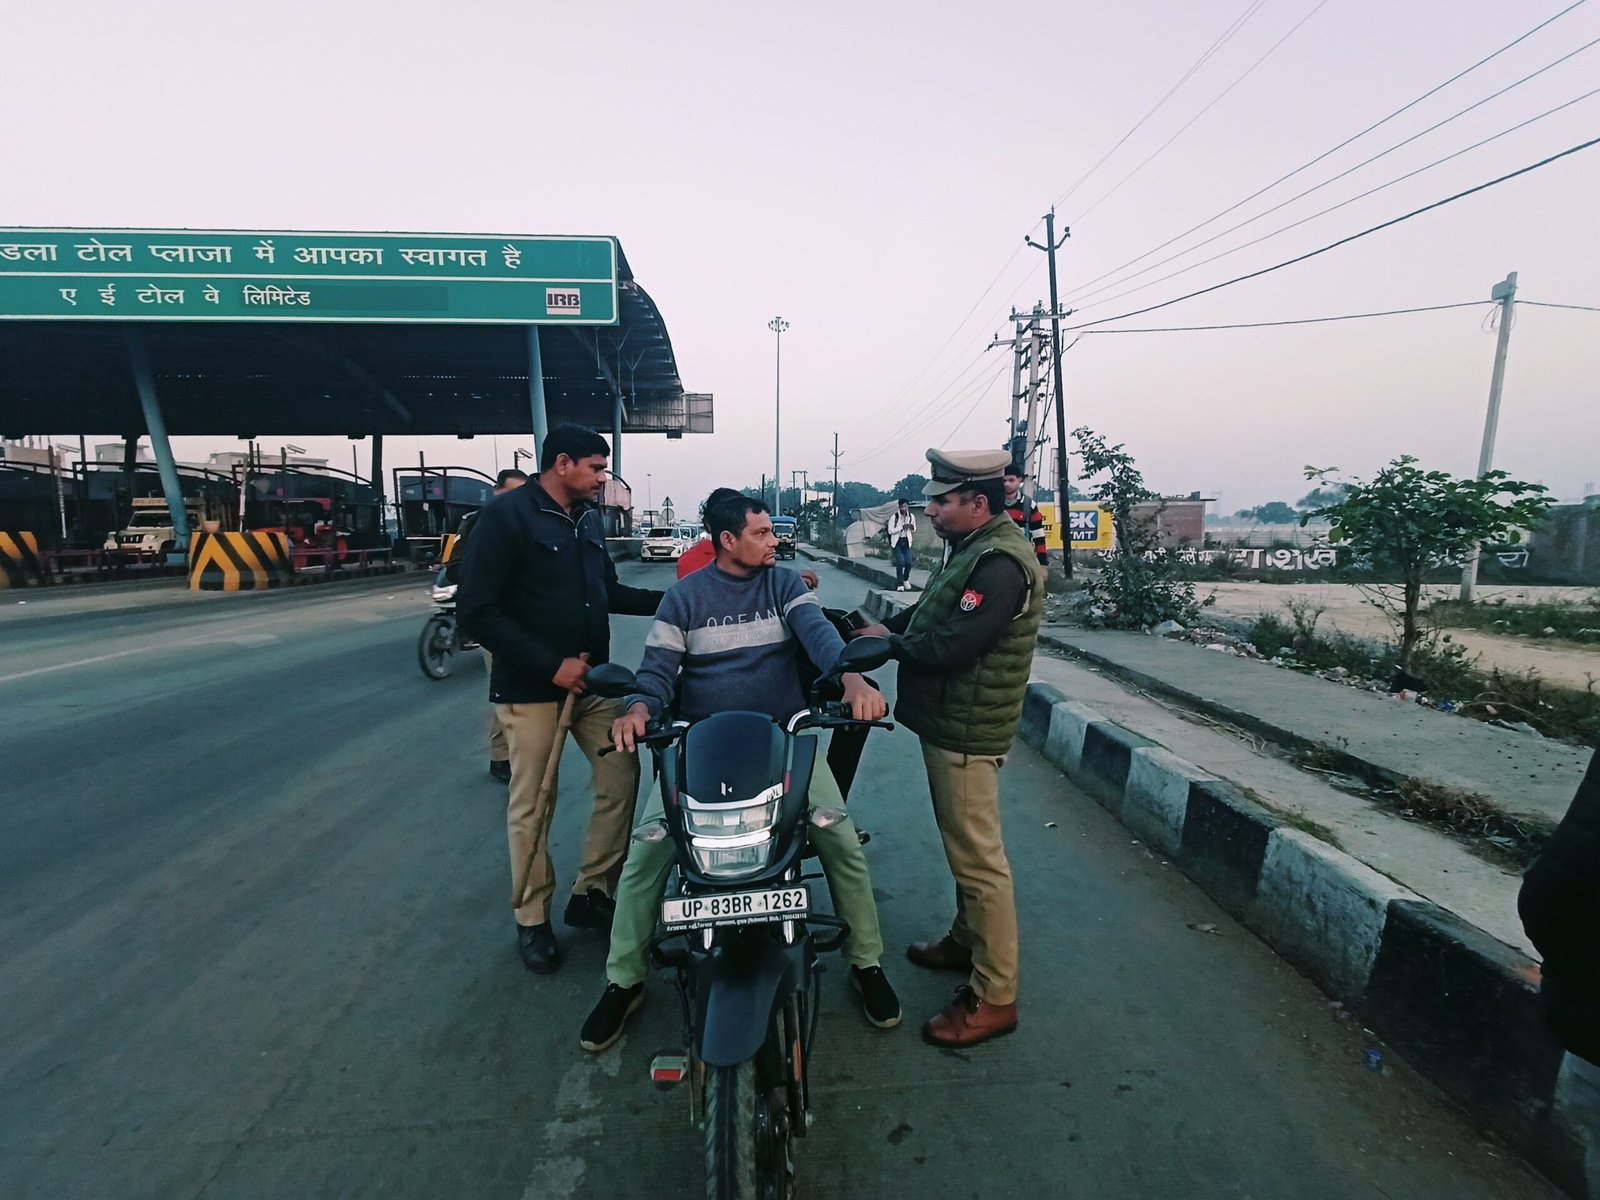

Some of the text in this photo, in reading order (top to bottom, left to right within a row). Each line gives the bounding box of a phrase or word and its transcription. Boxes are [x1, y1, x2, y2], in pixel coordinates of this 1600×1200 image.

[74, 238, 133, 262] टोल
[148, 245, 232, 263] प्लाजा
[253, 240, 275, 264] में
[293, 247, 383, 265] आपका
[399, 248, 487, 267] स्वागत
[502, 243, 521, 269] है
[59, 283, 310, 306] ए ई टोल वे लिमिटेड
[547, 293, 580, 306] IRB
[1070, 531, 1094, 540] MT
[707, 607, 779, 632] OCEAN
[682, 900, 703, 918] UP
[711, 895, 752, 915] 83BR
[763, 892, 803, 911] 1262
